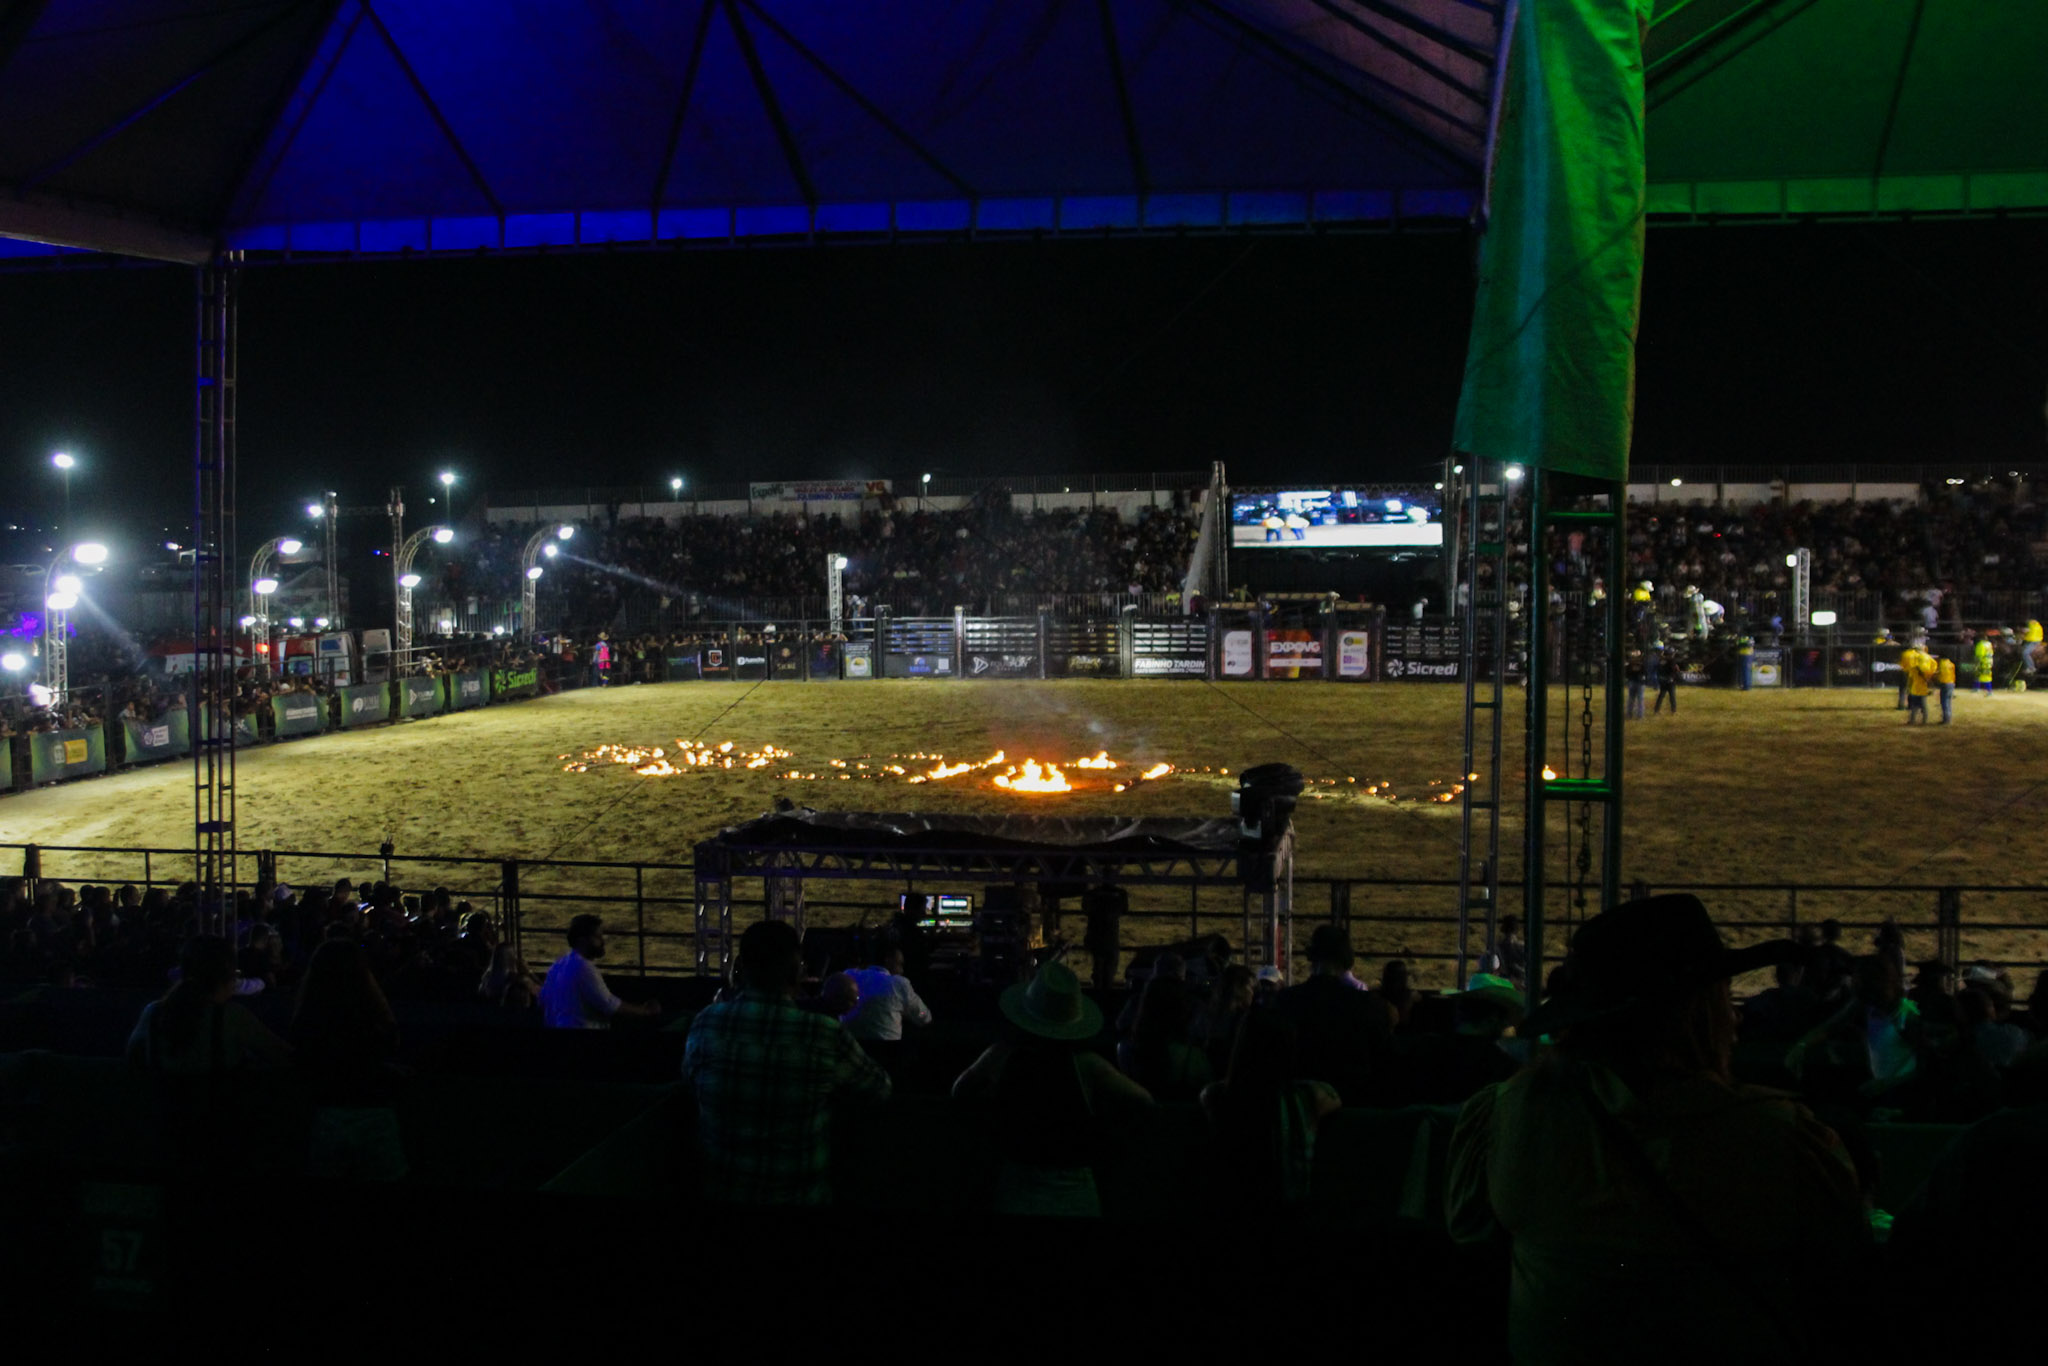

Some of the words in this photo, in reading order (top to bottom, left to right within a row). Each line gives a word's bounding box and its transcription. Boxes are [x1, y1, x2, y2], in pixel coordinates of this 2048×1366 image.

[1270, 641, 1321, 654] EXPOVG
[1135, 659, 1173, 669] FABINHO
[1174, 659, 1206, 668] TARDIN
[1407, 662, 1459, 675] Sicredi
